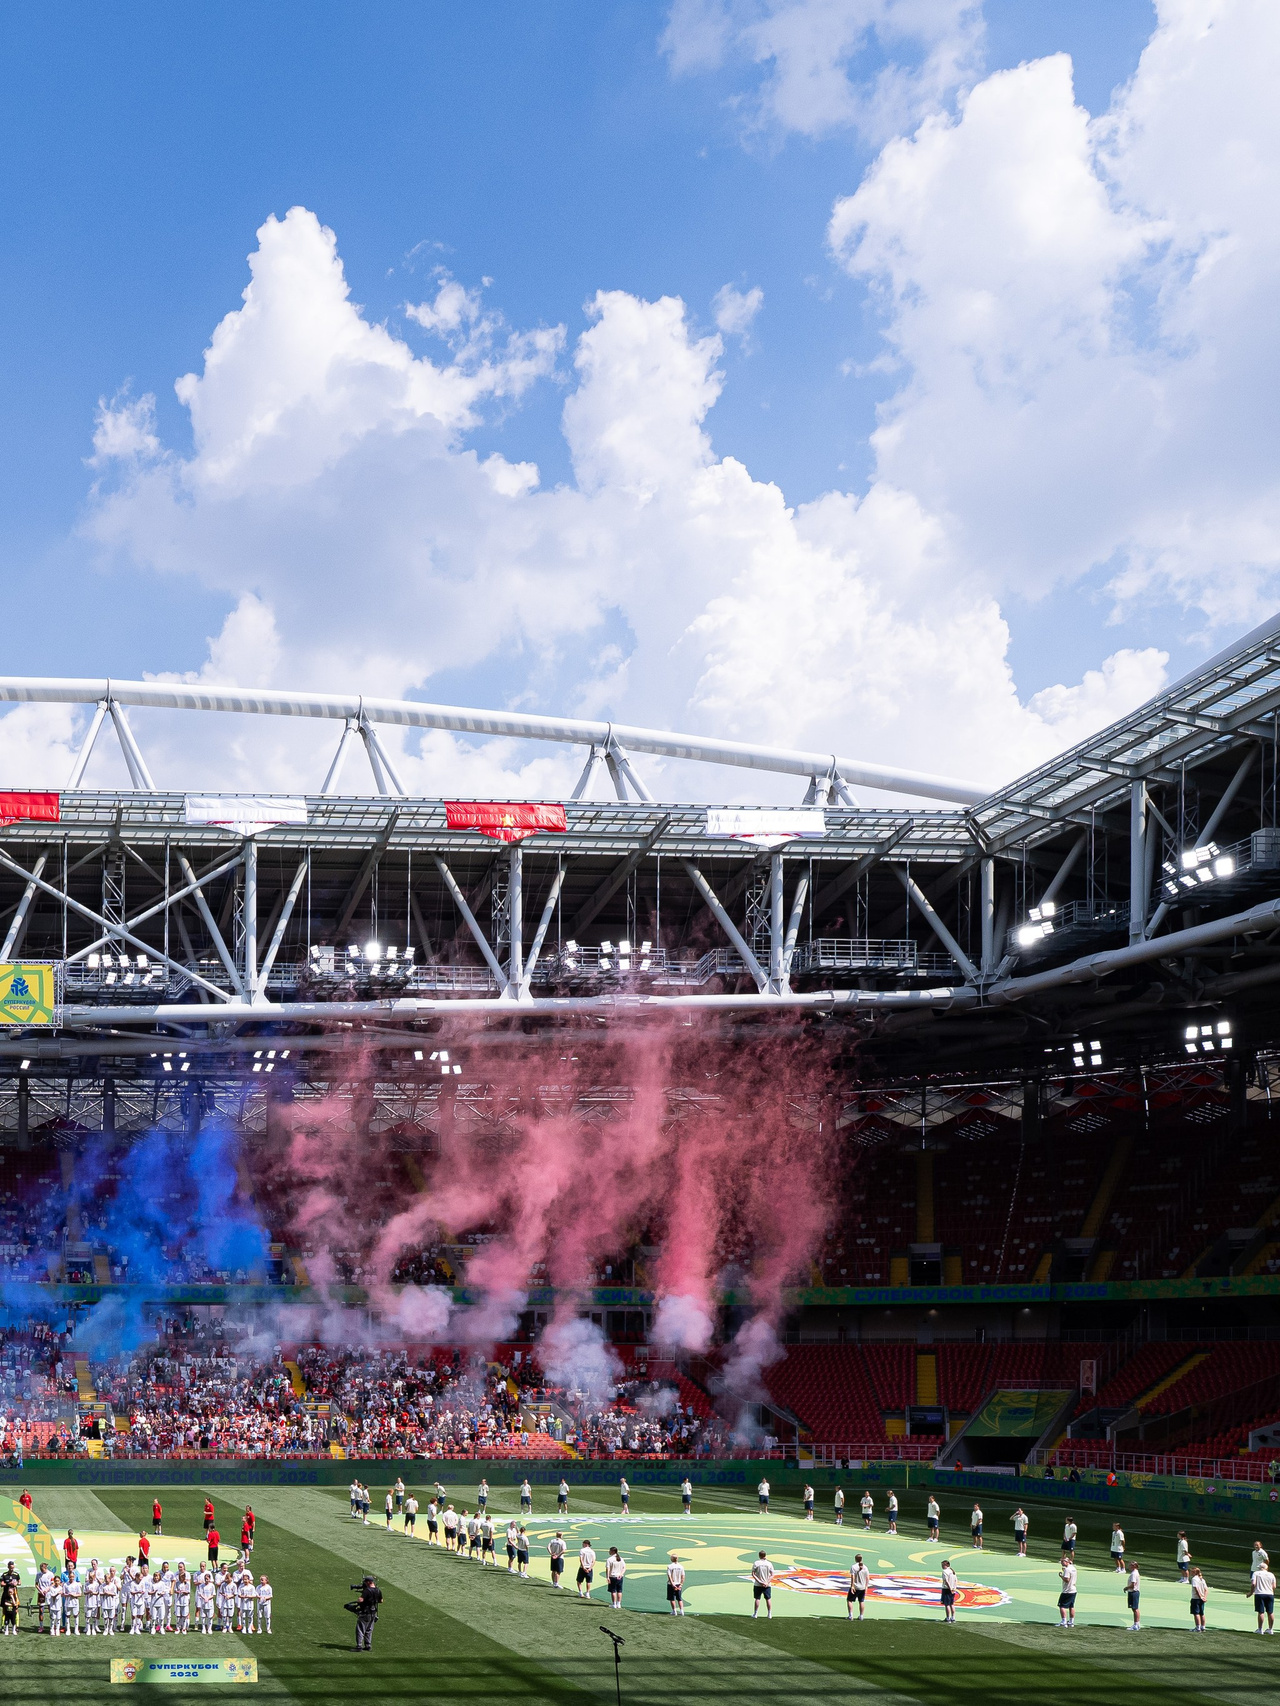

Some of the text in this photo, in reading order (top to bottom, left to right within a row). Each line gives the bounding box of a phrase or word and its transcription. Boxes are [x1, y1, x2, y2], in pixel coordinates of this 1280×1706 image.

[855, 1286, 1108, 1301] СУПЕРКУБОК РОССИИ 2026
[77, 1470, 318, 1483] СУПЕРКУБОК РОССИИ 2026
[513, 1470, 746, 1483] СУПЕРКУБОК РОССИИ 2026
[934, 1472, 1021, 1492] СУПЕРКУБОК
[1023, 1479, 1076, 1498] РОССИИ
[1079, 1487, 1110, 1502] 2026
